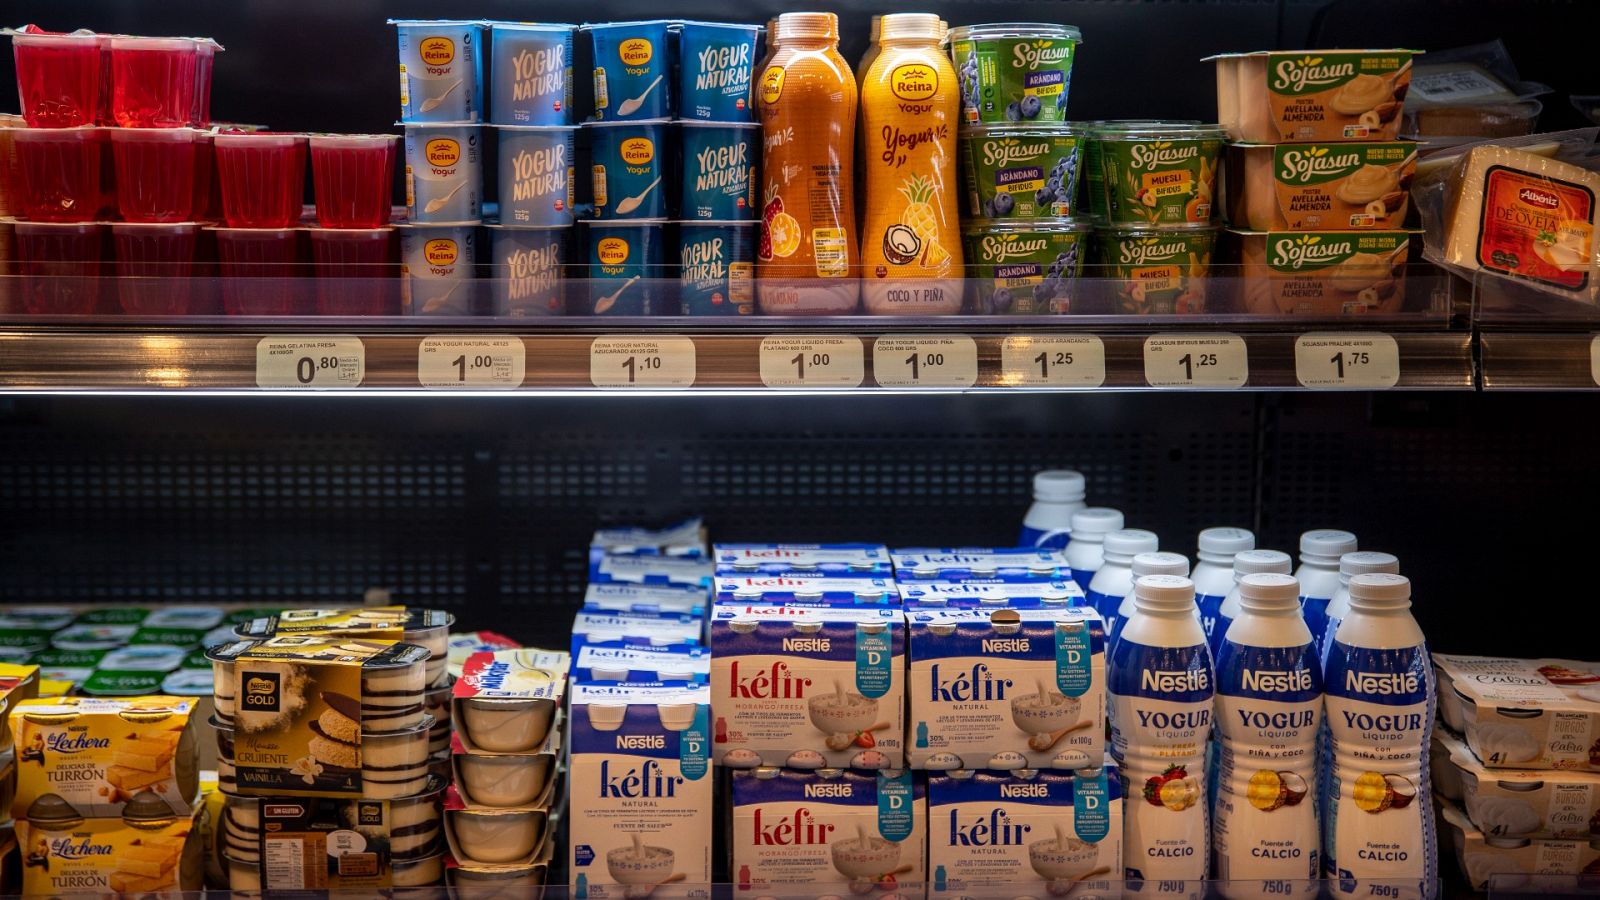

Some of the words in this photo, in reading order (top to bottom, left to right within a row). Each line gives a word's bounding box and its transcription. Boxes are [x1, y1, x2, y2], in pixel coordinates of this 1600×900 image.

[425, 51, 450, 59] Reina
[513, 44, 564, 80] YOGUR
[624, 52, 648, 60] Reina
[699, 43, 749, 72] YOGUR
[1013, 43, 1069, 70] Sojasun
[426, 67, 450, 75] Yogur
[626, 68, 649, 76] Yogur
[696, 66, 749, 90] NATURAL
[1275, 61, 1354, 92] Sojasun
[513, 71, 564, 101] NATURAL
[897, 82, 932, 91] Reina
[1037, 87, 1056, 95] BIFIDUS
[899, 104, 933, 115] Yogur
[697, 142, 746, 173] YOGUR
[983, 141, 1049, 167] Sojasun
[1131, 145, 1198, 170] Sojasun
[513, 144, 564, 181] YOGUR
[1282, 152, 1360, 182] Sojasun
[432, 168, 456, 177] Yogur
[627, 167, 650, 175] Yogur
[696, 165, 748, 191] NATURAL
[1152, 174, 1181, 184] MUESLI
[513, 171, 566, 201] NATURAL
[1008, 182, 1033, 192] BIFIDUS
[1156, 186, 1181, 194] BIFIDUS
[1521, 190, 1558, 205] Albéniz
[1497, 207, 1513, 220] DE
[1516, 214, 1557, 233] OVEJA
[681, 238, 723, 270] YOGUR
[982, 236, 1047, 262] Sojasun
[1120, 240, 1186, 264] Sojasun
[1273, 239, 1352, 268] Sojasun
[508, 243, 559, 278] YOGUR
[430, 268, 454, 276] Yogur
[601, 266, 624, 275] Yogur
[1140, 270, 1170, 278] MUESLI
[888, 291, 909, 301] COCO
[914, 290, 919, 301] Y
[924, 288, 943, 301] PIÑA
[297, 357, 337, 383] 0,80
[452, 355, 492, 381] 1,00
[622, 357, 660, 382] 1,10
[792, 353, 829, 379] 1,00
[906, 353, 943, 379] 1,00
[1035, 352, 1073, 378] 1,25
[1179, 354, 1217, 379] 1,25
[1331, 352, 1369, 378] 1,75
[783, 638, 830, 651] Nestlé
[982, 639, 1029, 652] Nestlé
[868, 652, 880, 665] D
[1067, 651, 1080, 663] D
[729, 661, 812, 699] kéfir
[930, 663, 1012, 702] kéfir
[1142, 668, 1207, 692] Nestlé
[1242, 669, 1311, 692] Nestlé
[1345, 670, 1417, 694] Nestlé
[247, 695, 275, 705] GOLD
[1137, 710, 1209, 728] YOGUR
[1238, 710, 1313, 729] YOGUR
[1343, 711, 1421, 731] YOGUR
[1555, 721, 1585, 733] BURGOS
[51, 733, 110, 749] Lechera
[617, 736, 664, 749] Nestlé
[689, 743, 699, 752] D
[1550, 742, 1584, 753] Cabra
[238, 753, 288, 764] CRUJIENTE
[1249, 749, 1270, 757] PIÑA
[47, 767, 104, 782] TURRÓN
[244, 773, 281, 782] VAINILLA
[599, 760, 683, 797] kéfir
[805, 784, 851, 797] Nestlé
[1001, 785, 1048, 798] Nestlé
[1555, 793, 1586, 803] BURGOS
[889, 796, 902, 808] D
[1086, 796, 1098, 809] D
[752, 808, 834, 845] kéfir
[948, 808, 1031, 846] kéfir
[55, 839, 112, 855] Lechera
[1148, 847, 1193, 857] CALCIO
[1252, 848, 1300, 858] CALCIO
[1359, 850, 1407, 861] CALCIO
[51, 875, 107, 887] TURRÓN
